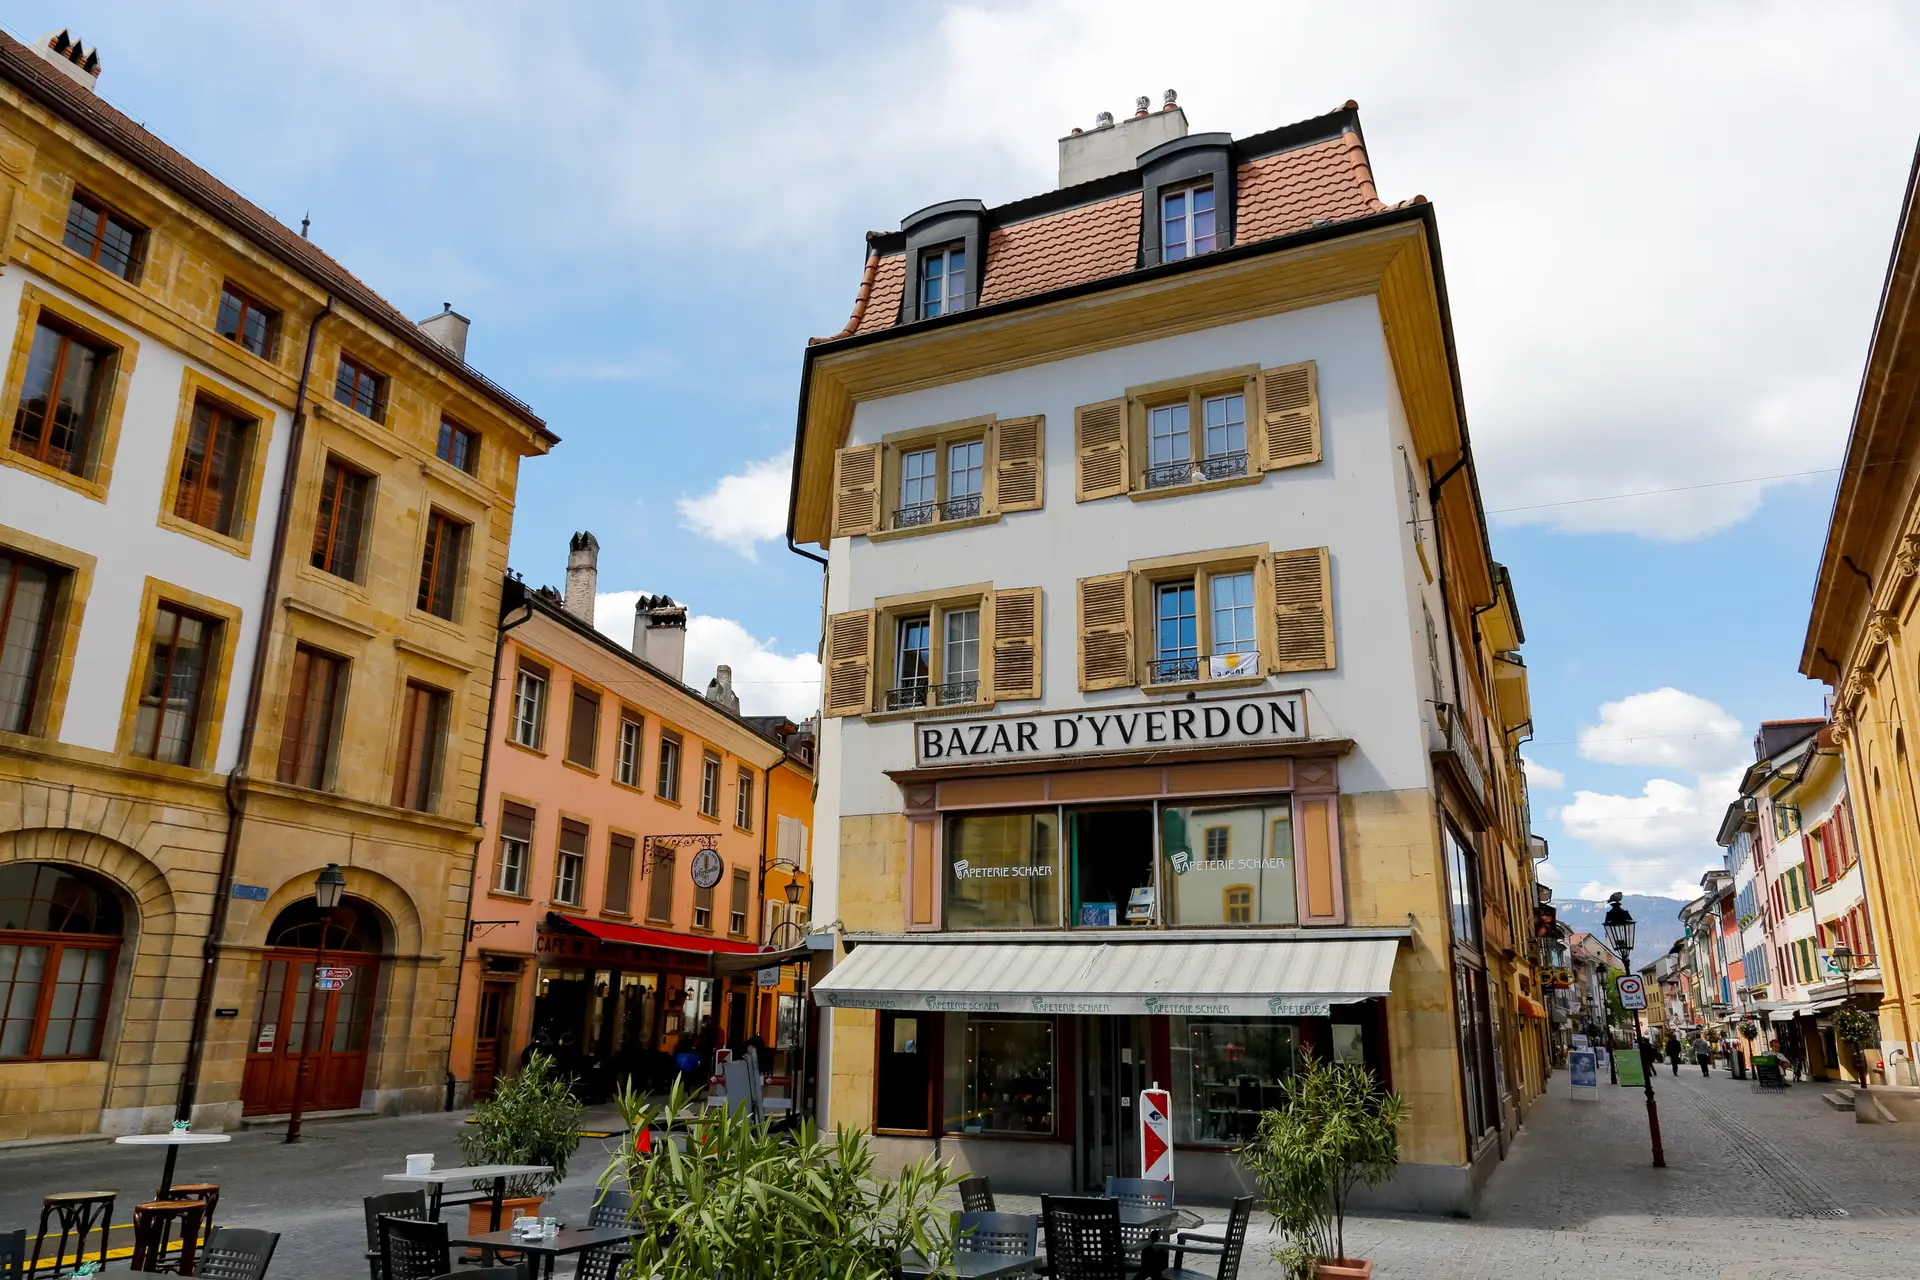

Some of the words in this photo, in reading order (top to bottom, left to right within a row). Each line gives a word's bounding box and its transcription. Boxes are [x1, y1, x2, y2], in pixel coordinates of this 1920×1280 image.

[922, 721, 1038, 759] BAZAR
[1054, 700, 1297, 749] D'YVERDON
[953, 859, 1010, 880] PAPETERIE
[1012, 866, 1052, 876] SCHAER
[1170, 851, 1235, 874] PAPETERIE
[1238, 858, 1285, 869] SCHAER
[828, 993, 867, 1007] PAPETERIE
[869, 999, 896, 1008] SCHAER
[925, 994, 967, 1011] PAPETERIE
[969, 1001, 1000, 1011] SCHAER
[1031, 996, 1076, 1012] PAPETERIE
[1077, 1003, 1110, 1012] SCHAER
[1145, 997, 1192, 1014] PAPETERIE
[1195, 1004, 1231, 1014] SCHAER
